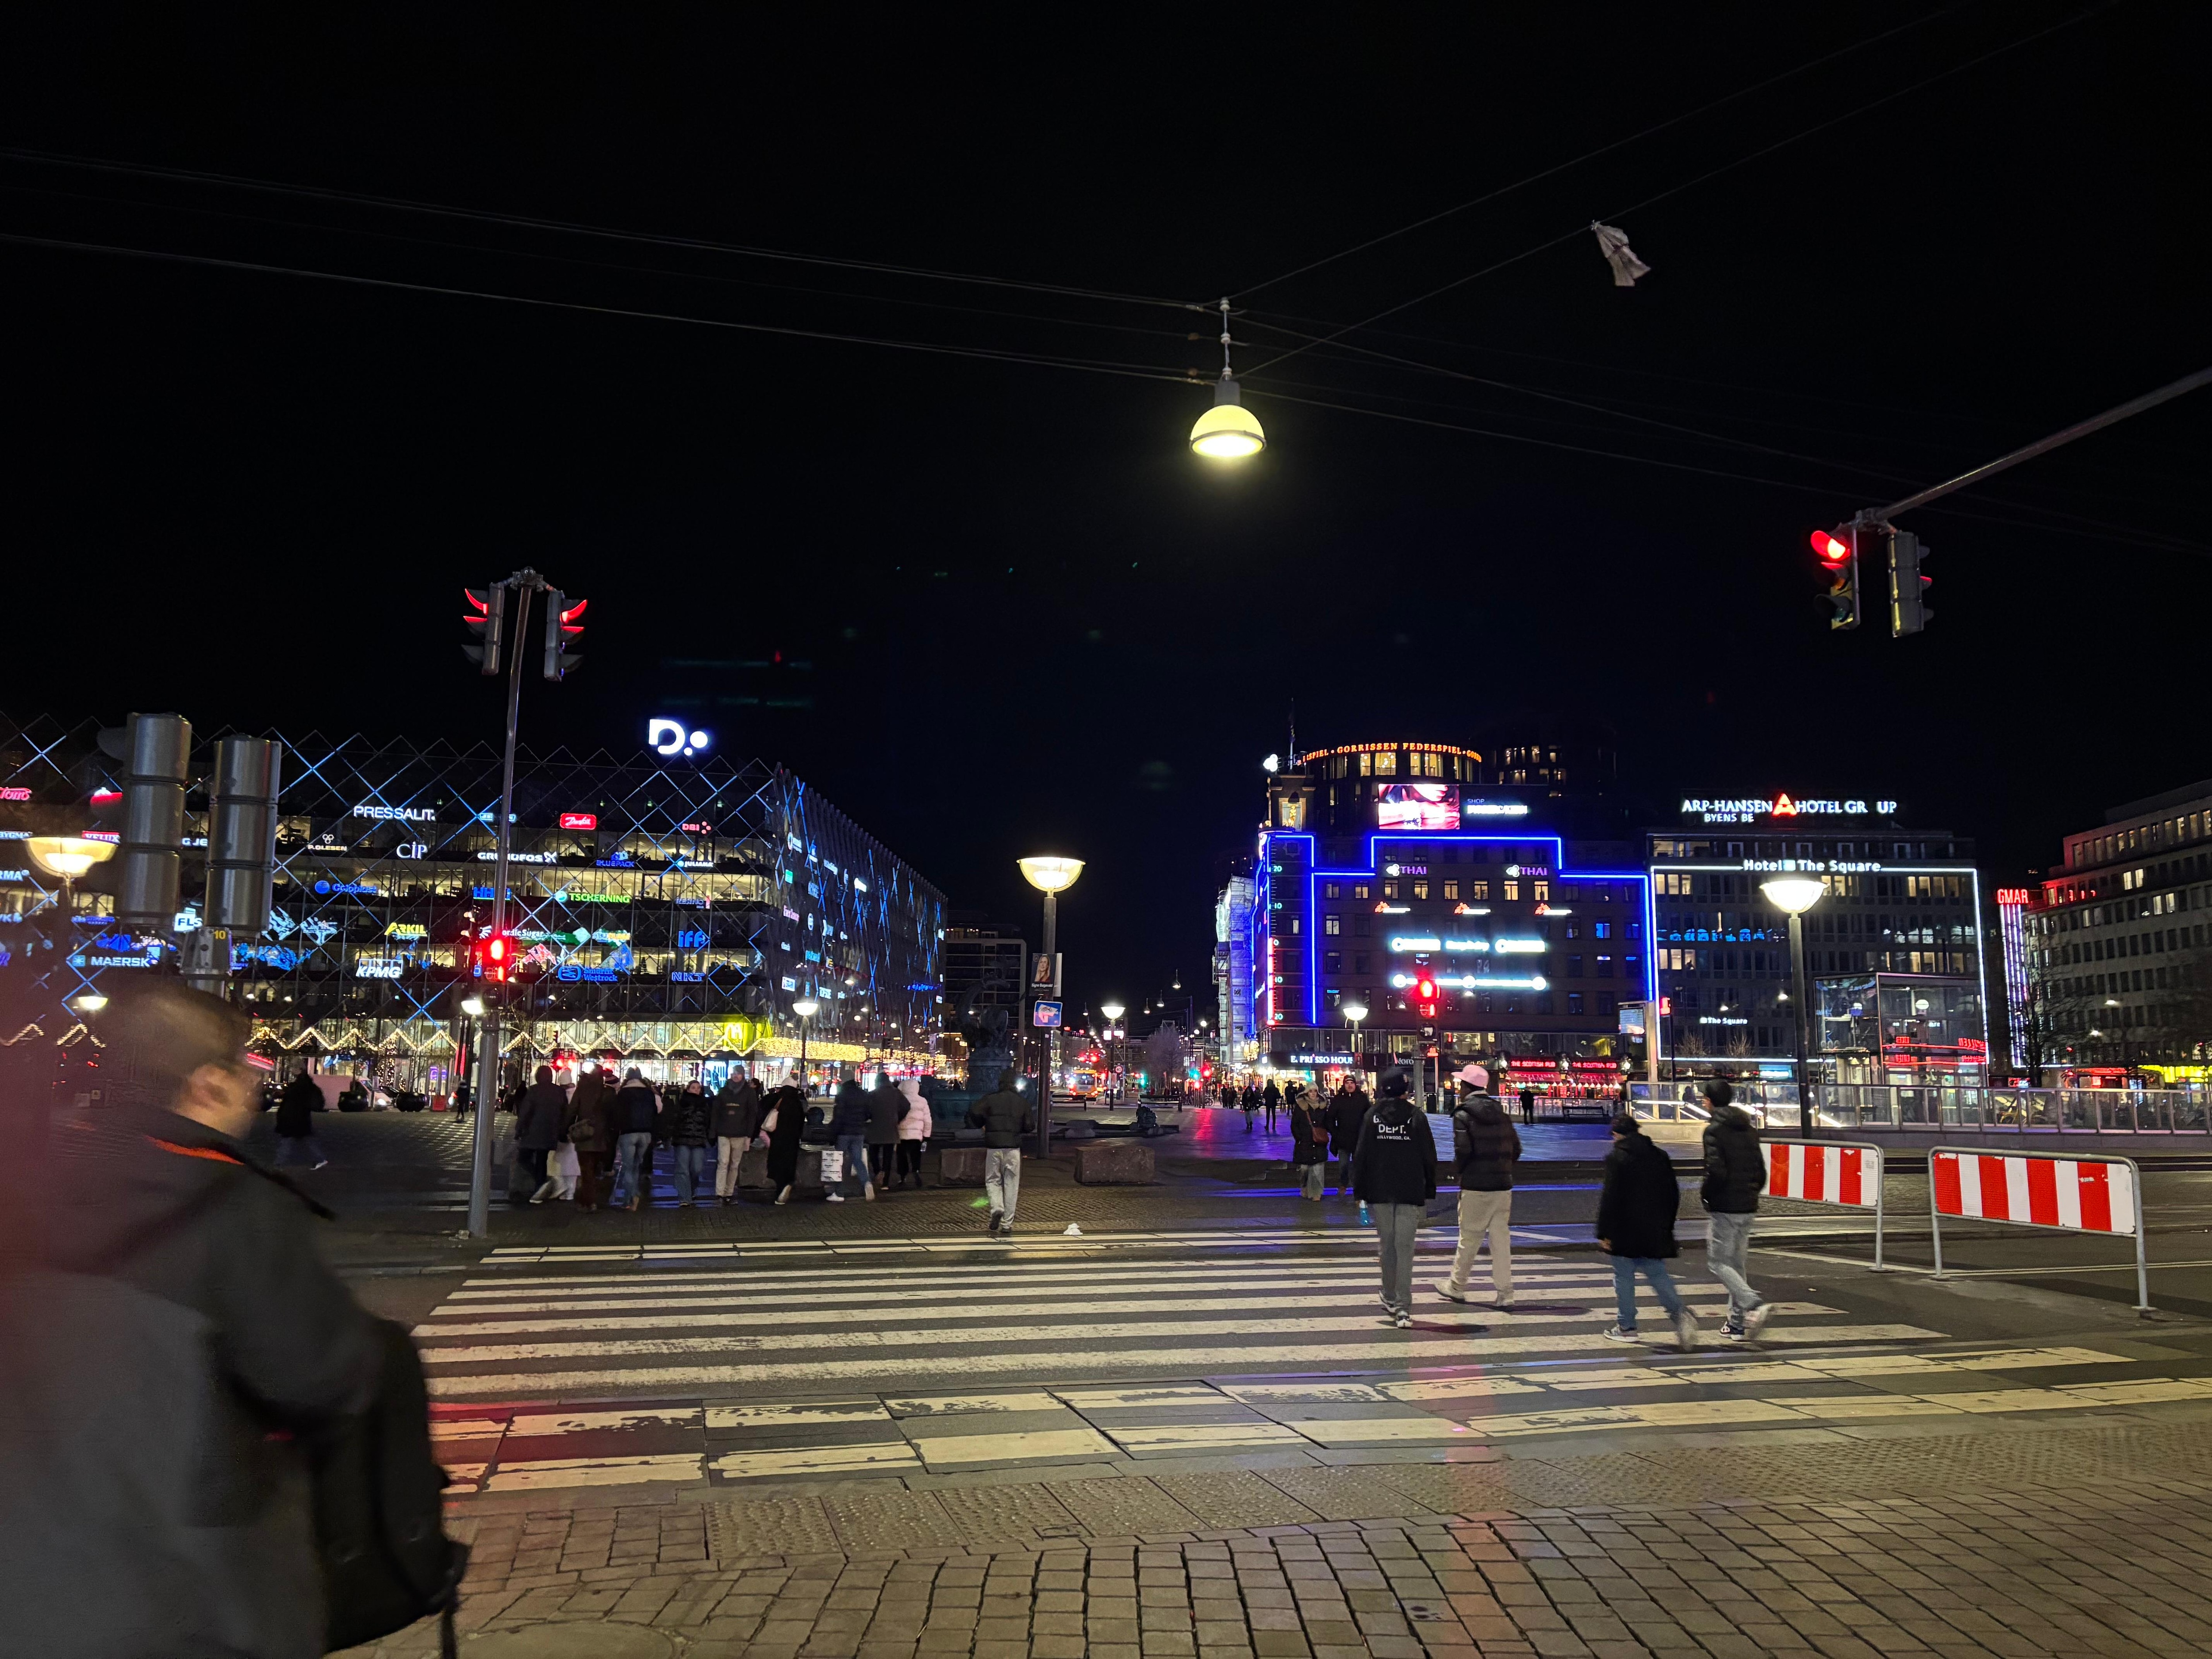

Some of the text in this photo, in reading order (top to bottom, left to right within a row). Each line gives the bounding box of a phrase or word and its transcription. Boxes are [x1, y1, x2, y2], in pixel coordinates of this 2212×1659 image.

[1336, 742, 1398, 754] GORRISSEN
[1402, 742, 1462, 755] FEDERSPIEL
[1682, 799, 1773, 812] ARP-HANSEN
[1795, 800, 1843, 813] HOTEL
[1704, 813, 1737, 823] BYENS
[1400, 866, 1427, 875] THAI
[1520, 866, 1548, 876] THAI
[1743, 860, 1881, 873] Hotel The Square
[214, 930, 226, 939] 10
[91, 956, 150, 967] MAERSK
[356, 966, 402, 978] KPMG
